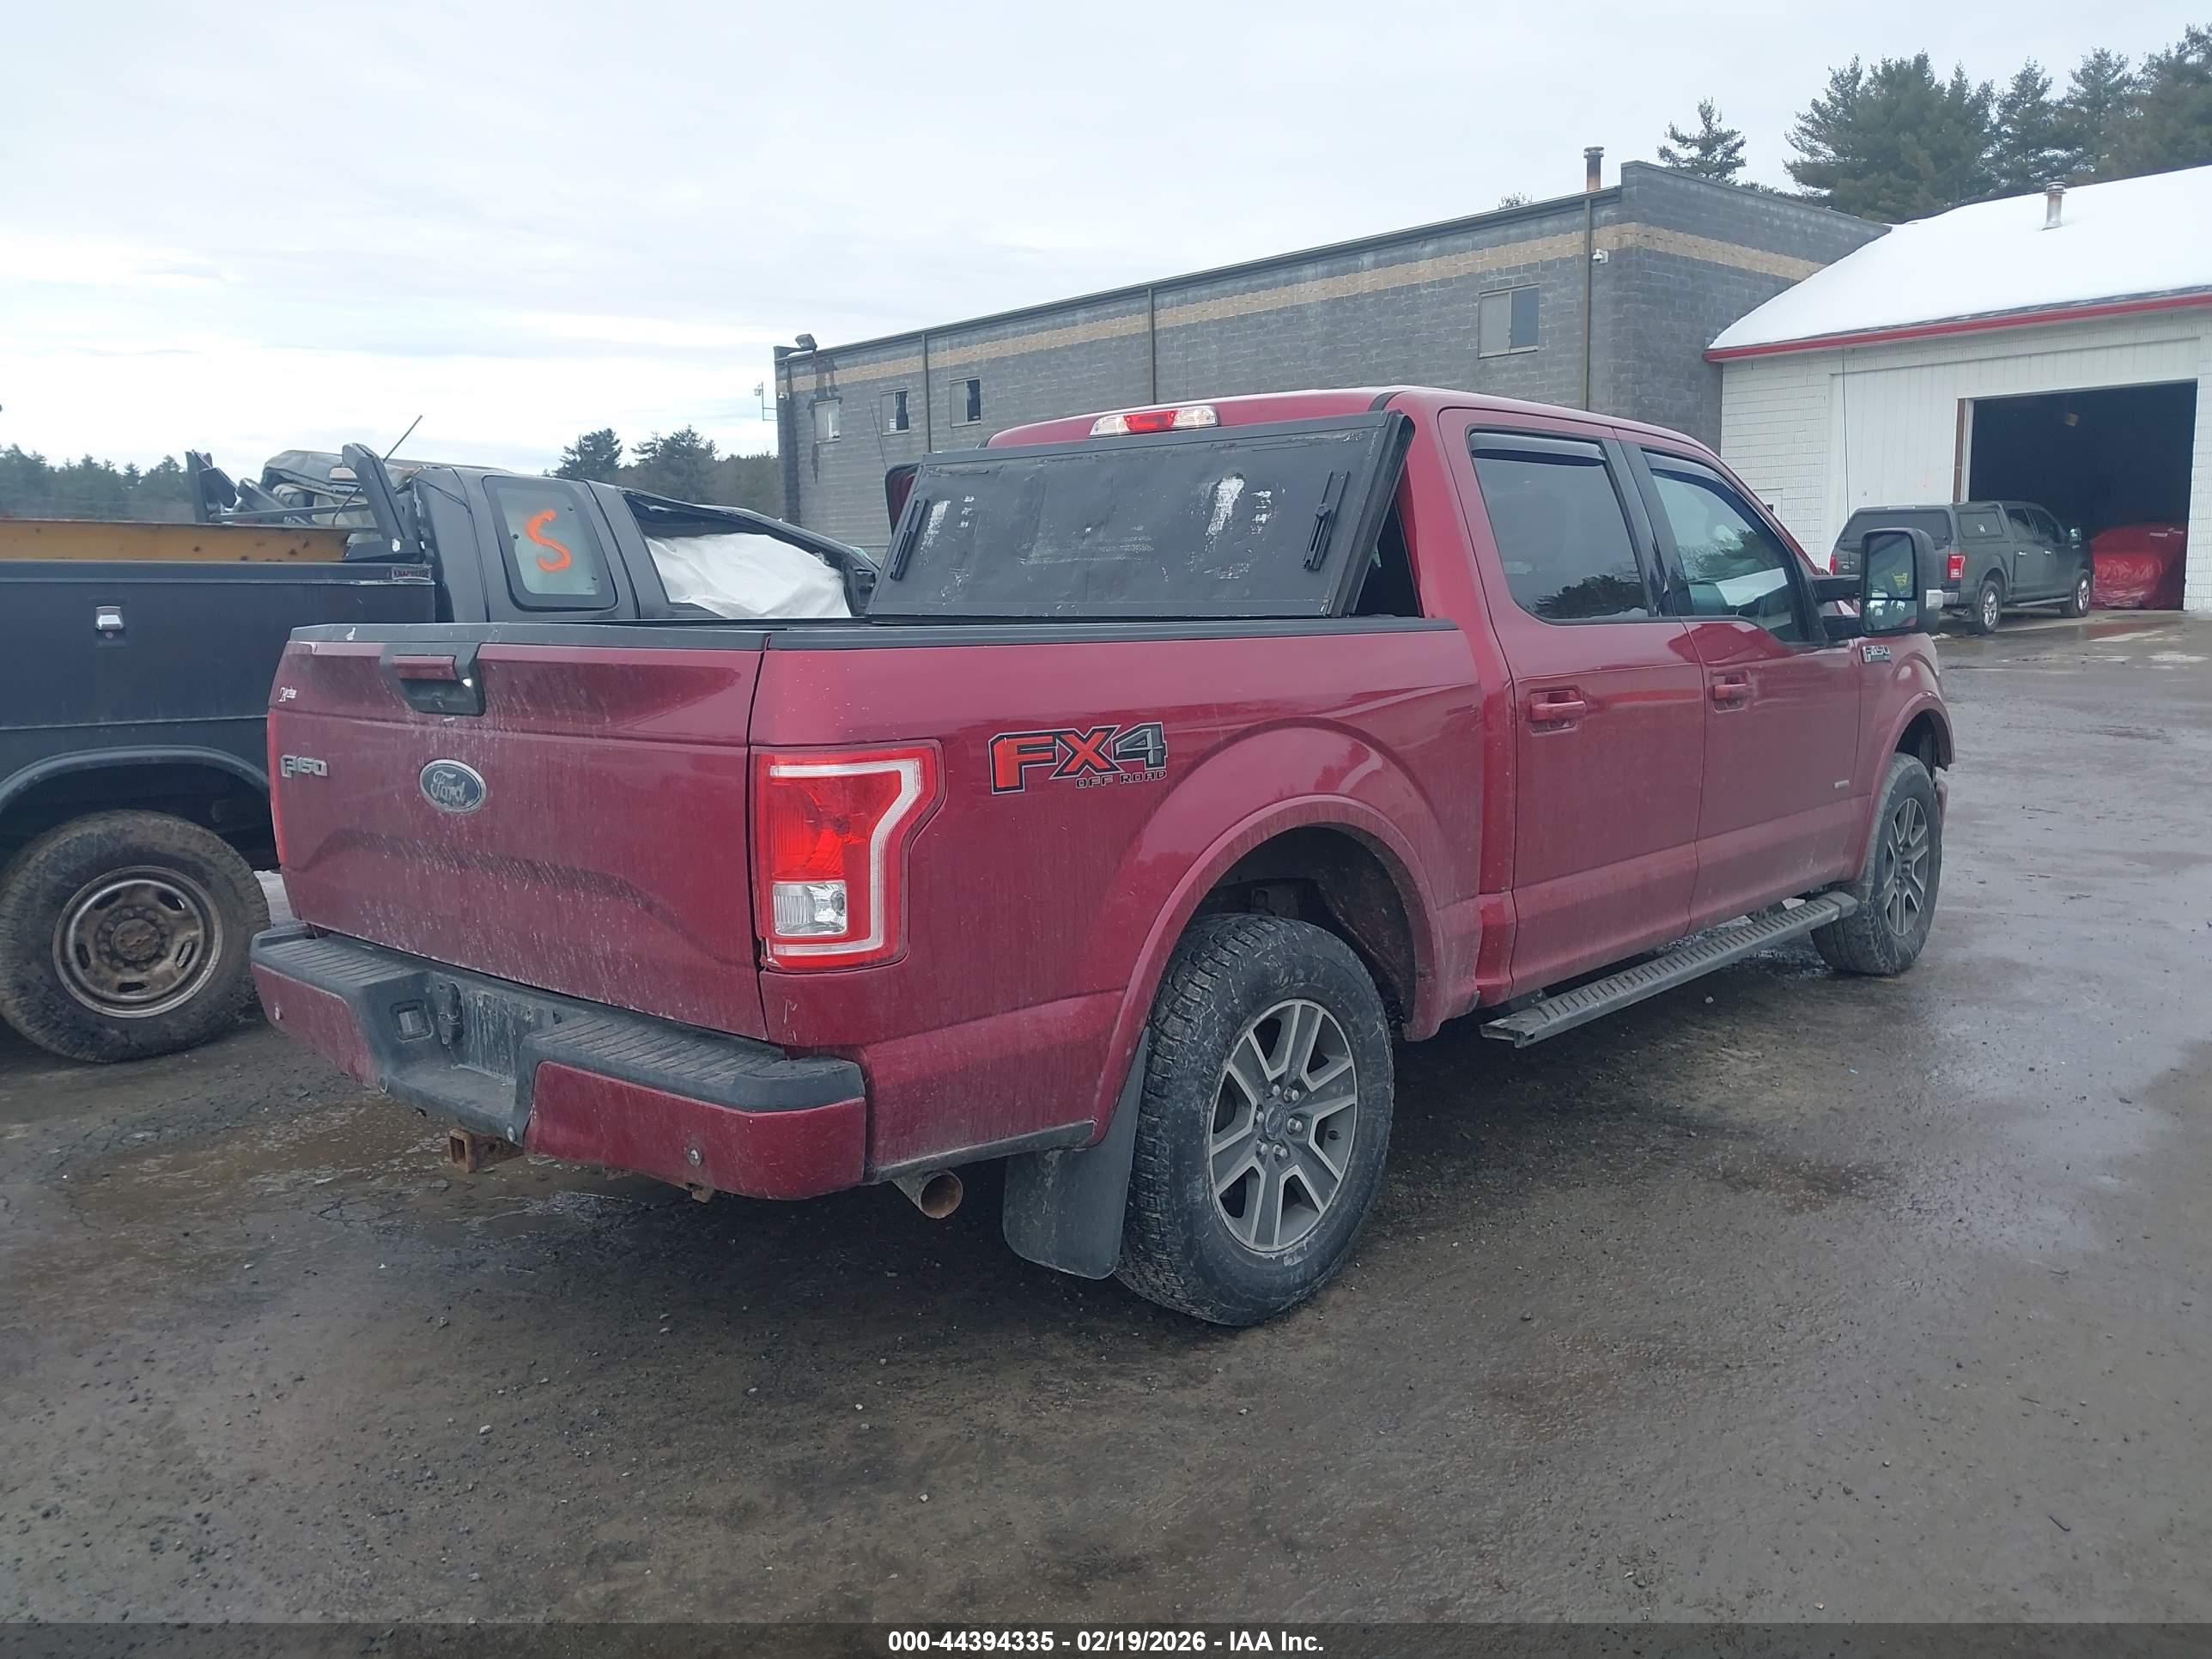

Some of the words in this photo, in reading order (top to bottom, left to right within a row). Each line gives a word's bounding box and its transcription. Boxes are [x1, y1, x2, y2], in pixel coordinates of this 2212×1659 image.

[525, 508, 573, 573] S
[988, 721, 1168, 795] FX4
[1076, 776, 1114, 789] OFF
[1120, 770, 1168, 785] ROAD
[430, 769, 466, 804] Ford
